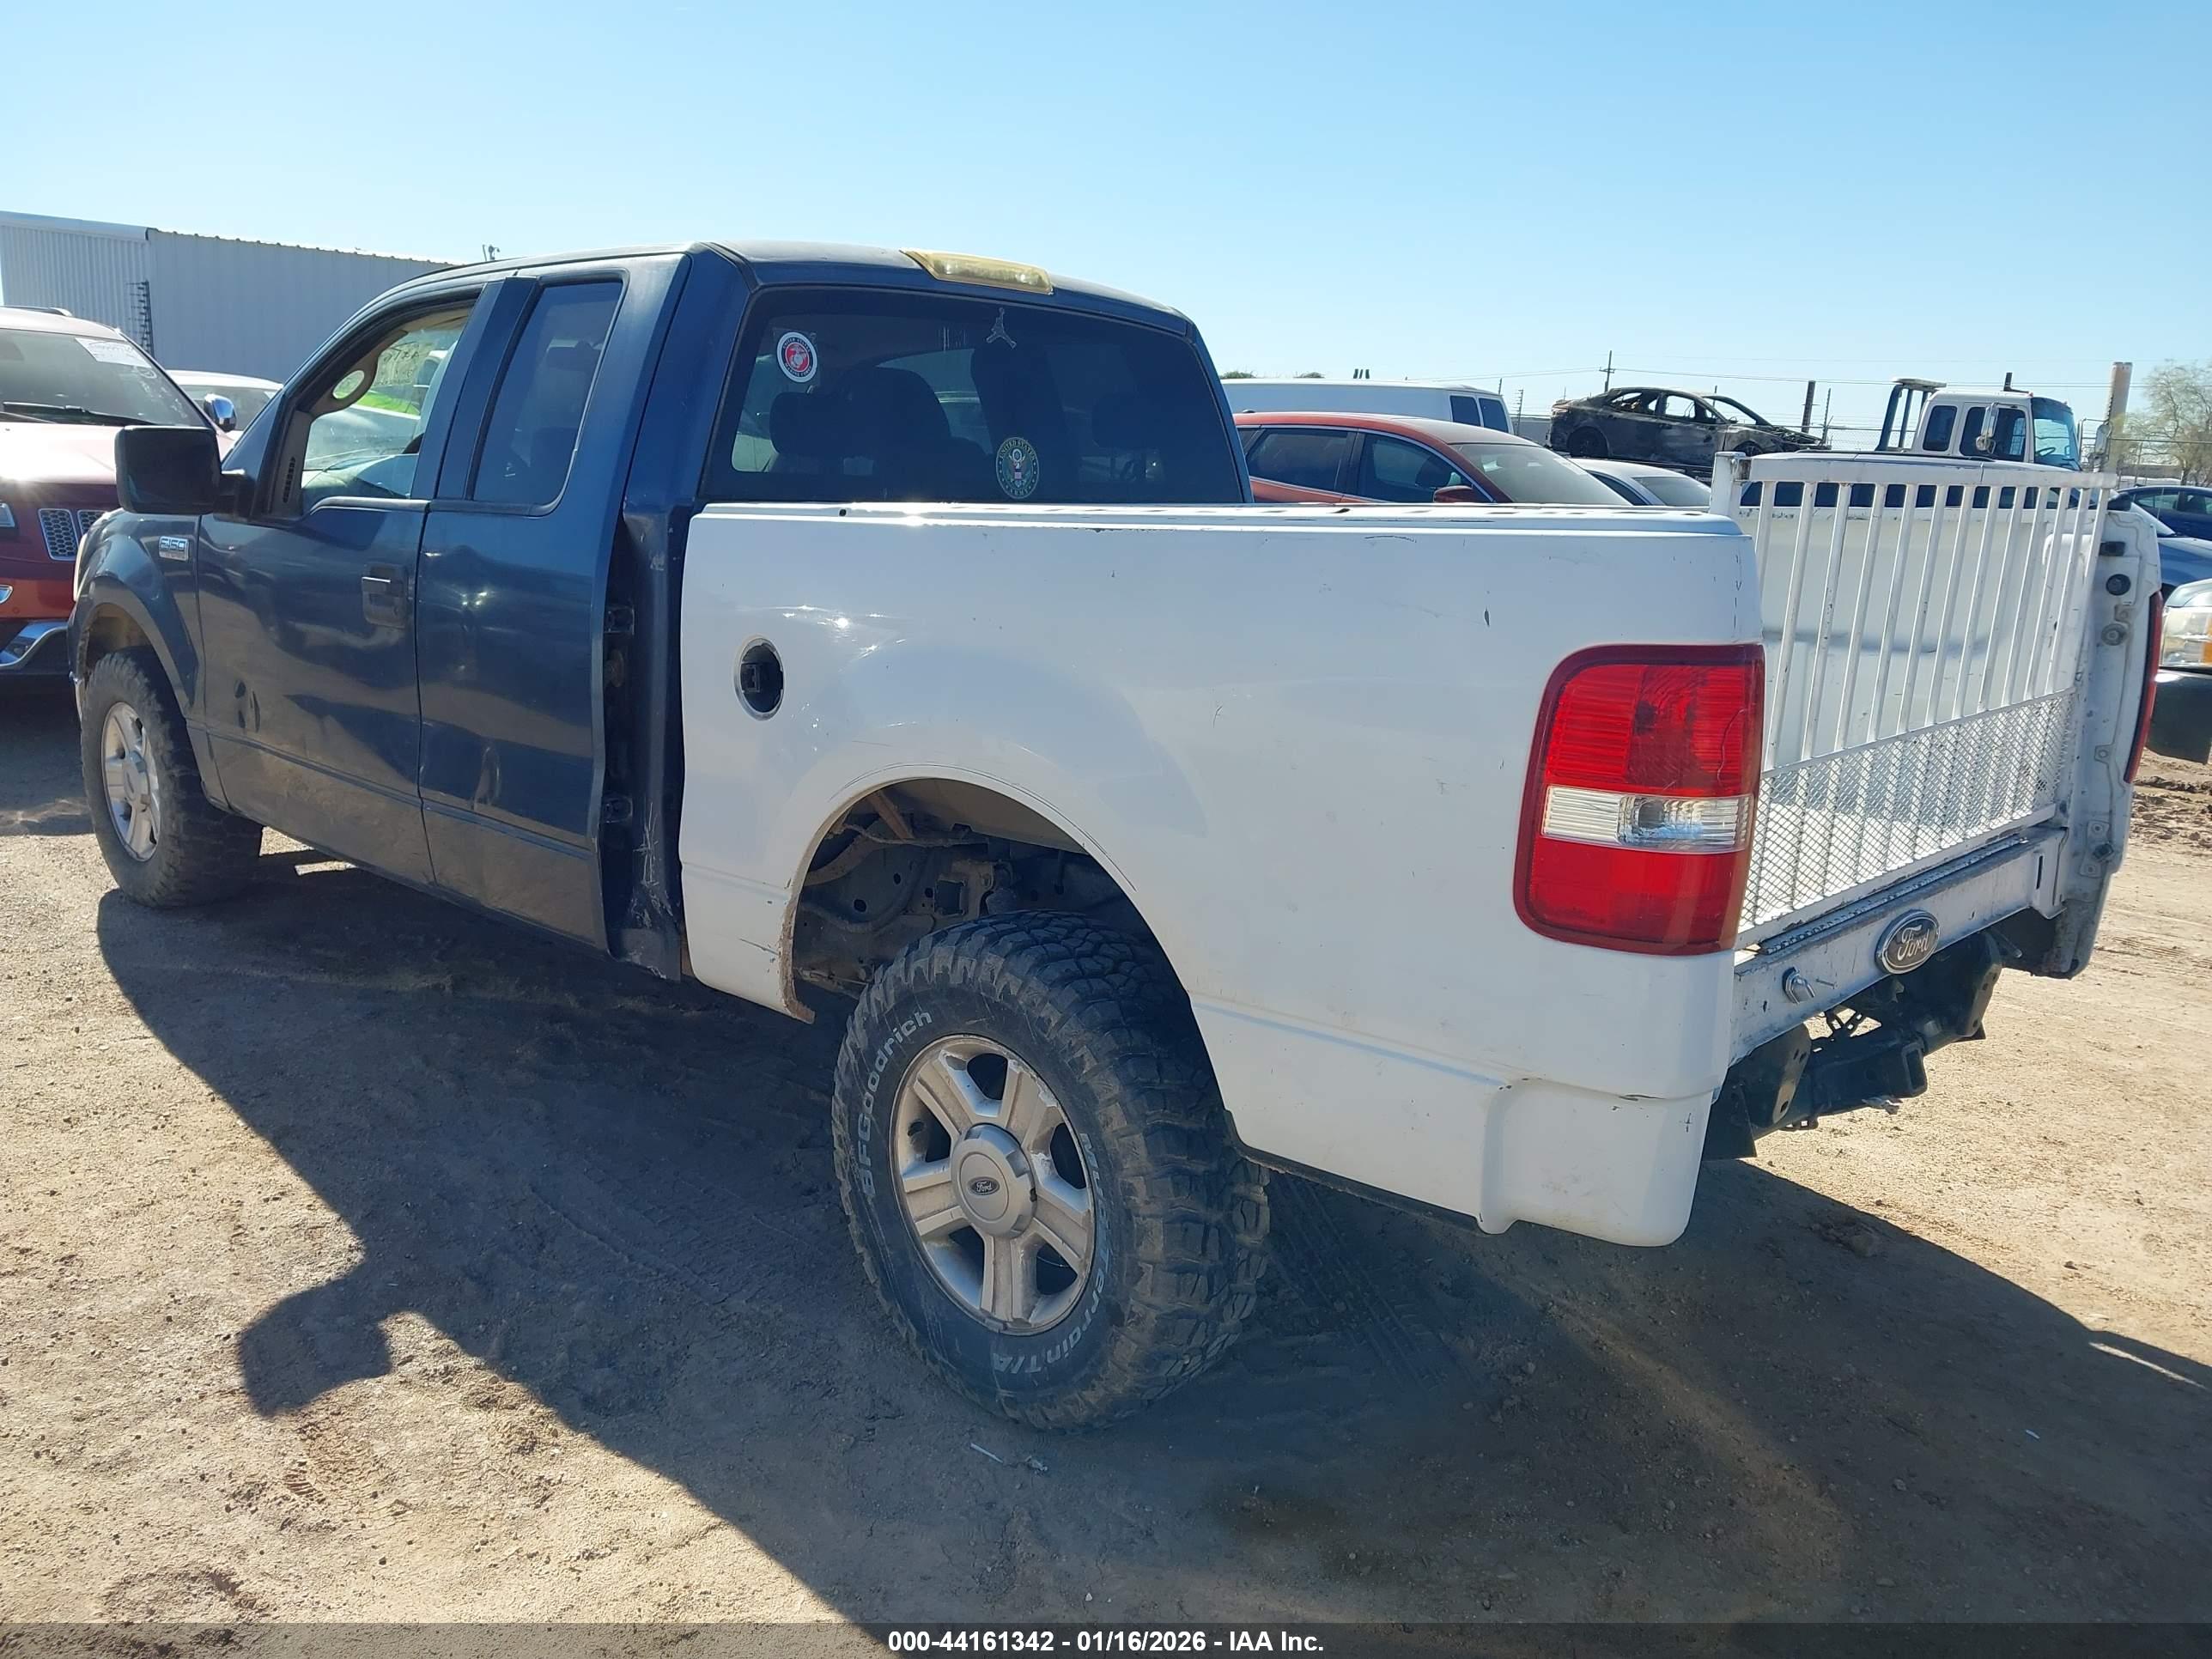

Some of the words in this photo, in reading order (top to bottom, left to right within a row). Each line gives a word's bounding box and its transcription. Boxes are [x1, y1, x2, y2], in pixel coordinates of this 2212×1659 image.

[999, 439, 1017, 459] UNITED
[1010, 488, 1029, 496] ARMY
[1897, 924, 1930, 961] Ford
[858, 1010, 933, 1195] BFGoodrich
